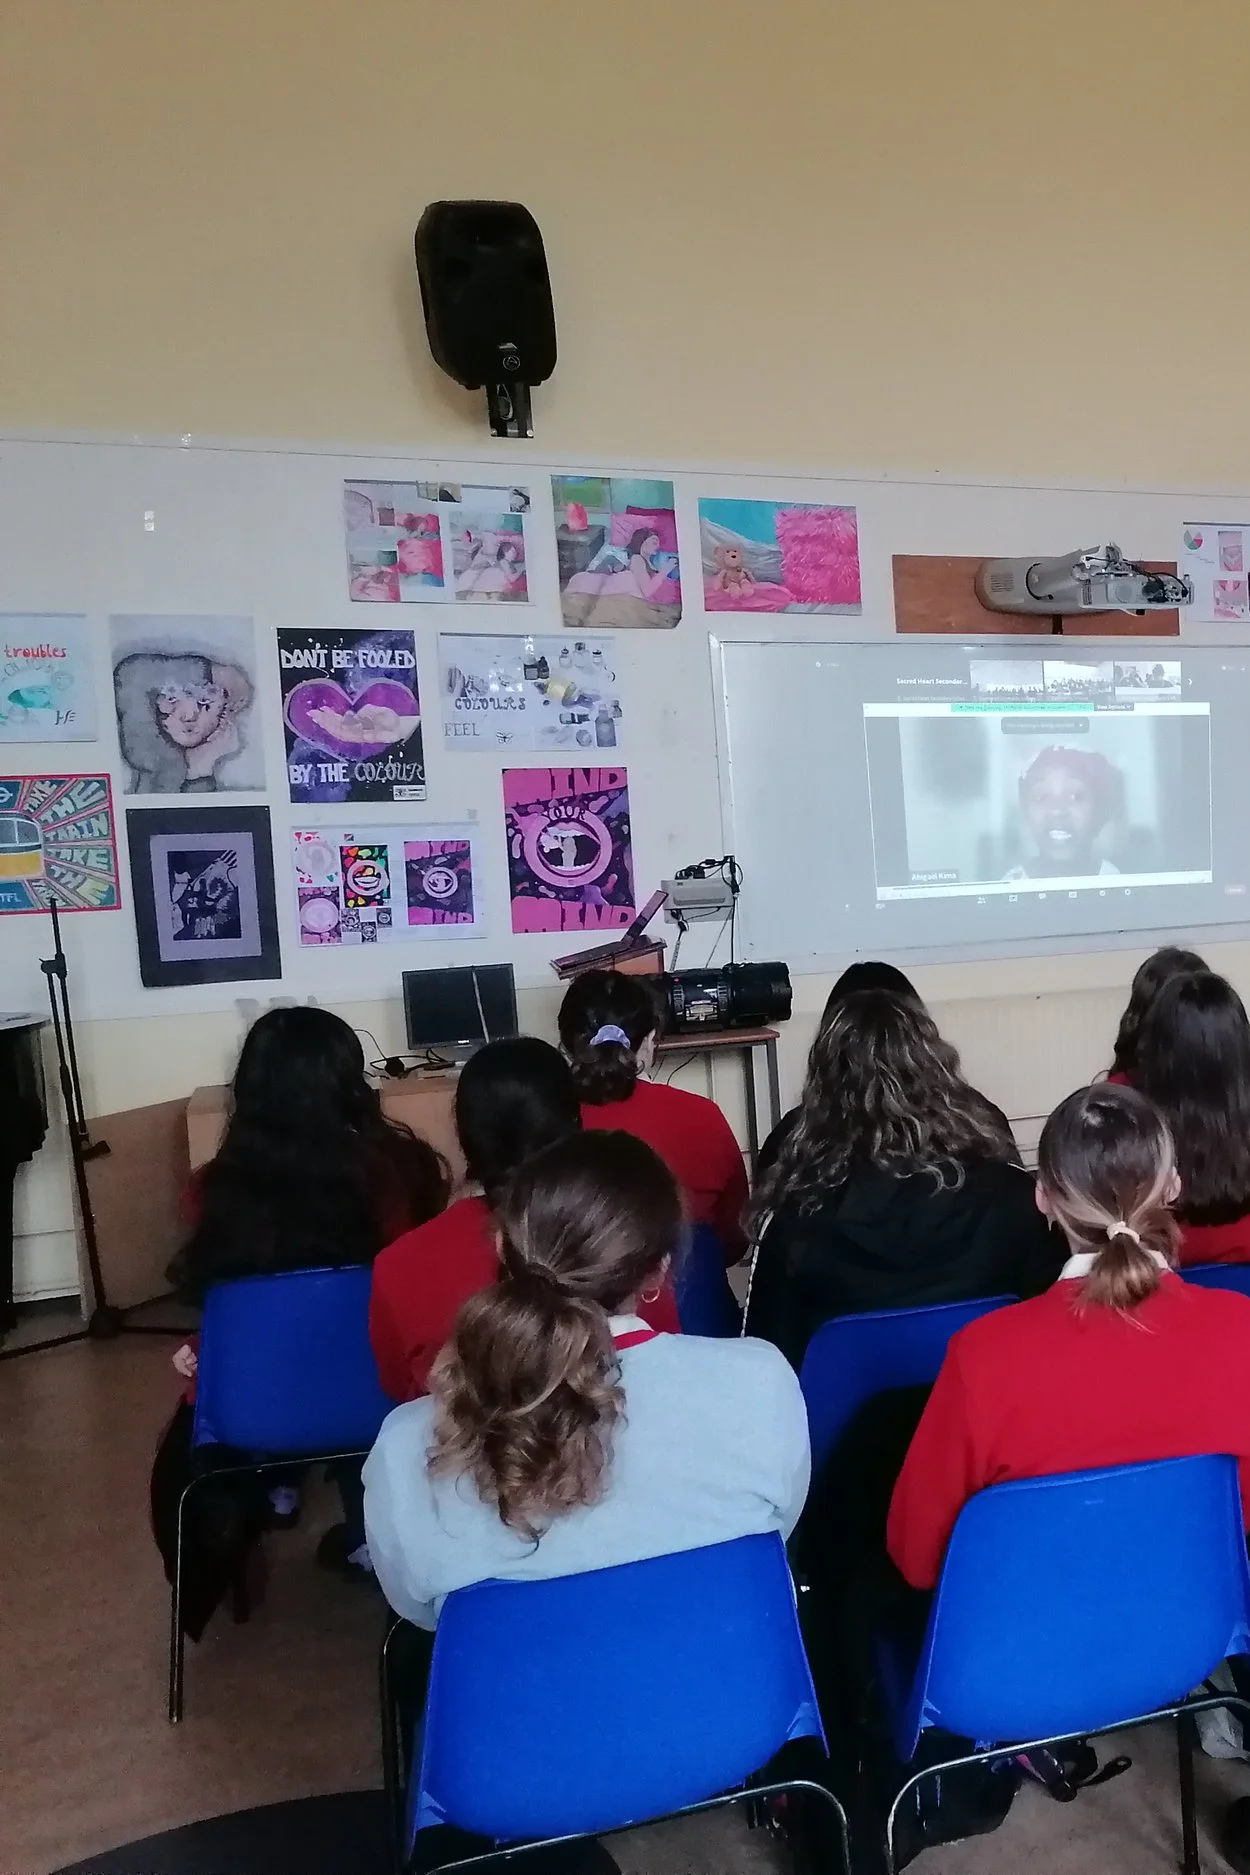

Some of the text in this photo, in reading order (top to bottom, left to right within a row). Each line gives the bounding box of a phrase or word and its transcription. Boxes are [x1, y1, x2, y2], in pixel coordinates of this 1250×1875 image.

[4, 643, 68, 658] troubles
[332, 649, 358, 668] BE
[358, 649, 416, 669] FOOLED
[455, 697, 526, 711] COLOURS
[444, 722, 480, 737] FEEL
[288, 764, 313, 784] BY
[317, 763, 349, 783] THE
